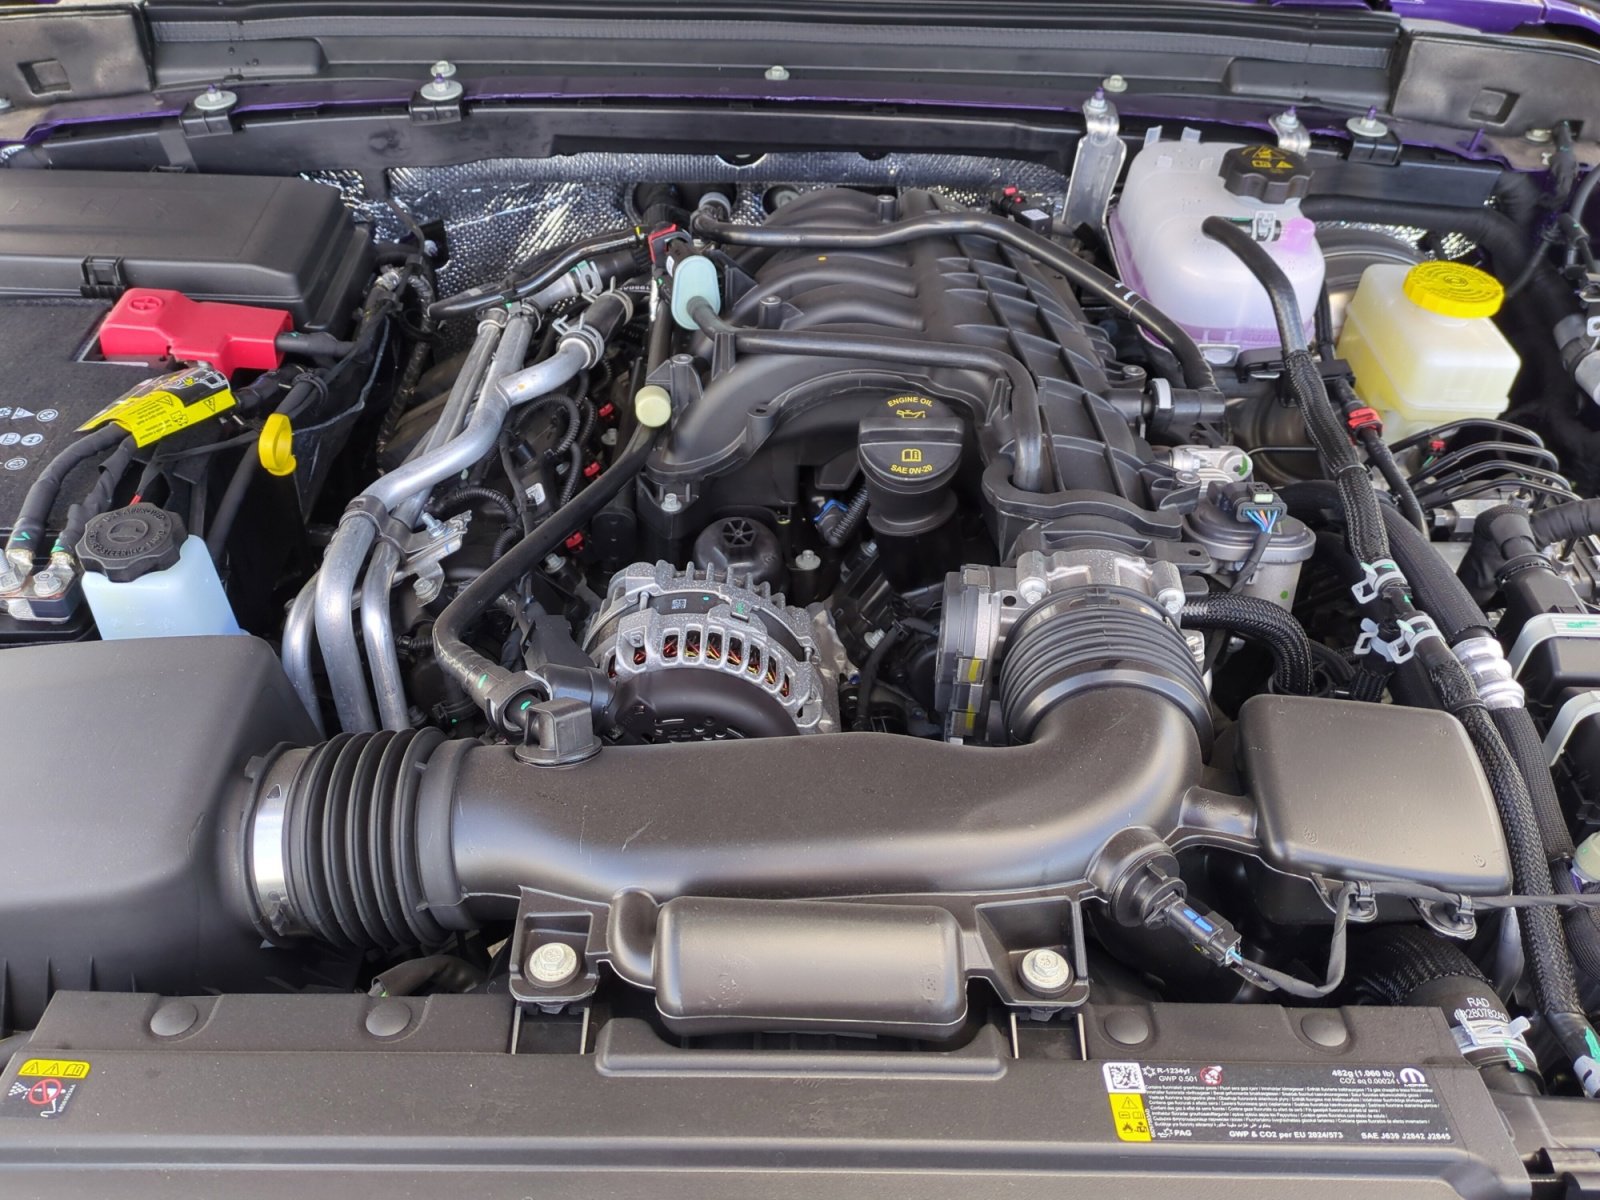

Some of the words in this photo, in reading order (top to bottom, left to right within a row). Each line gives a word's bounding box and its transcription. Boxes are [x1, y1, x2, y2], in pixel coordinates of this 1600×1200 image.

[887, 396, 919, 407] ENGINE
[920, 398, 933, 407] OIL
[890, 464, 908, 474] SAE
[908, 464, 933, 474] 0W-20
[1466, 997, 1490, 1007] RAD
[1174, 1129, 1192, 1137] PAG
